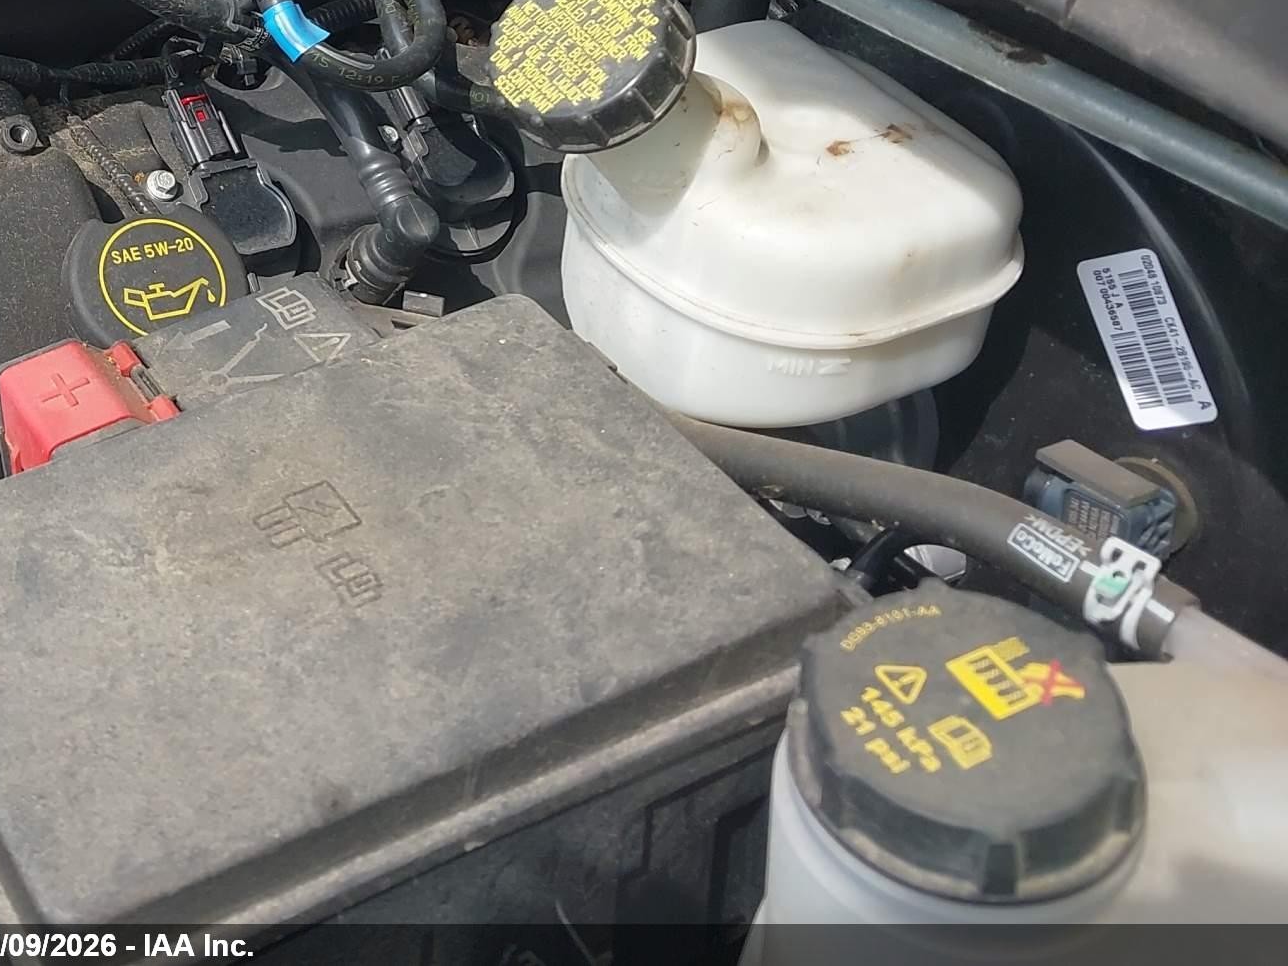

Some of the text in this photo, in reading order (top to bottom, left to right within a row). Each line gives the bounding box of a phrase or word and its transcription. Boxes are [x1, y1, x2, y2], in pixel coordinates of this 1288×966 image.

[636, 9, 659, 28] CAP
[496, 36, 516, 53] DOT
[537, 37, 553, 49] LE
[557, 36, 573, 49] LE
[598, 14, 624, 37] FLUID
[620, 35, 649, 60] FROM
[525, 46, 545, 62] QUE
[541, 63, 557, 75] DU
[110, 237, 194, 265] SAE 5W-20
[767, 357, 813, 375] MIN
